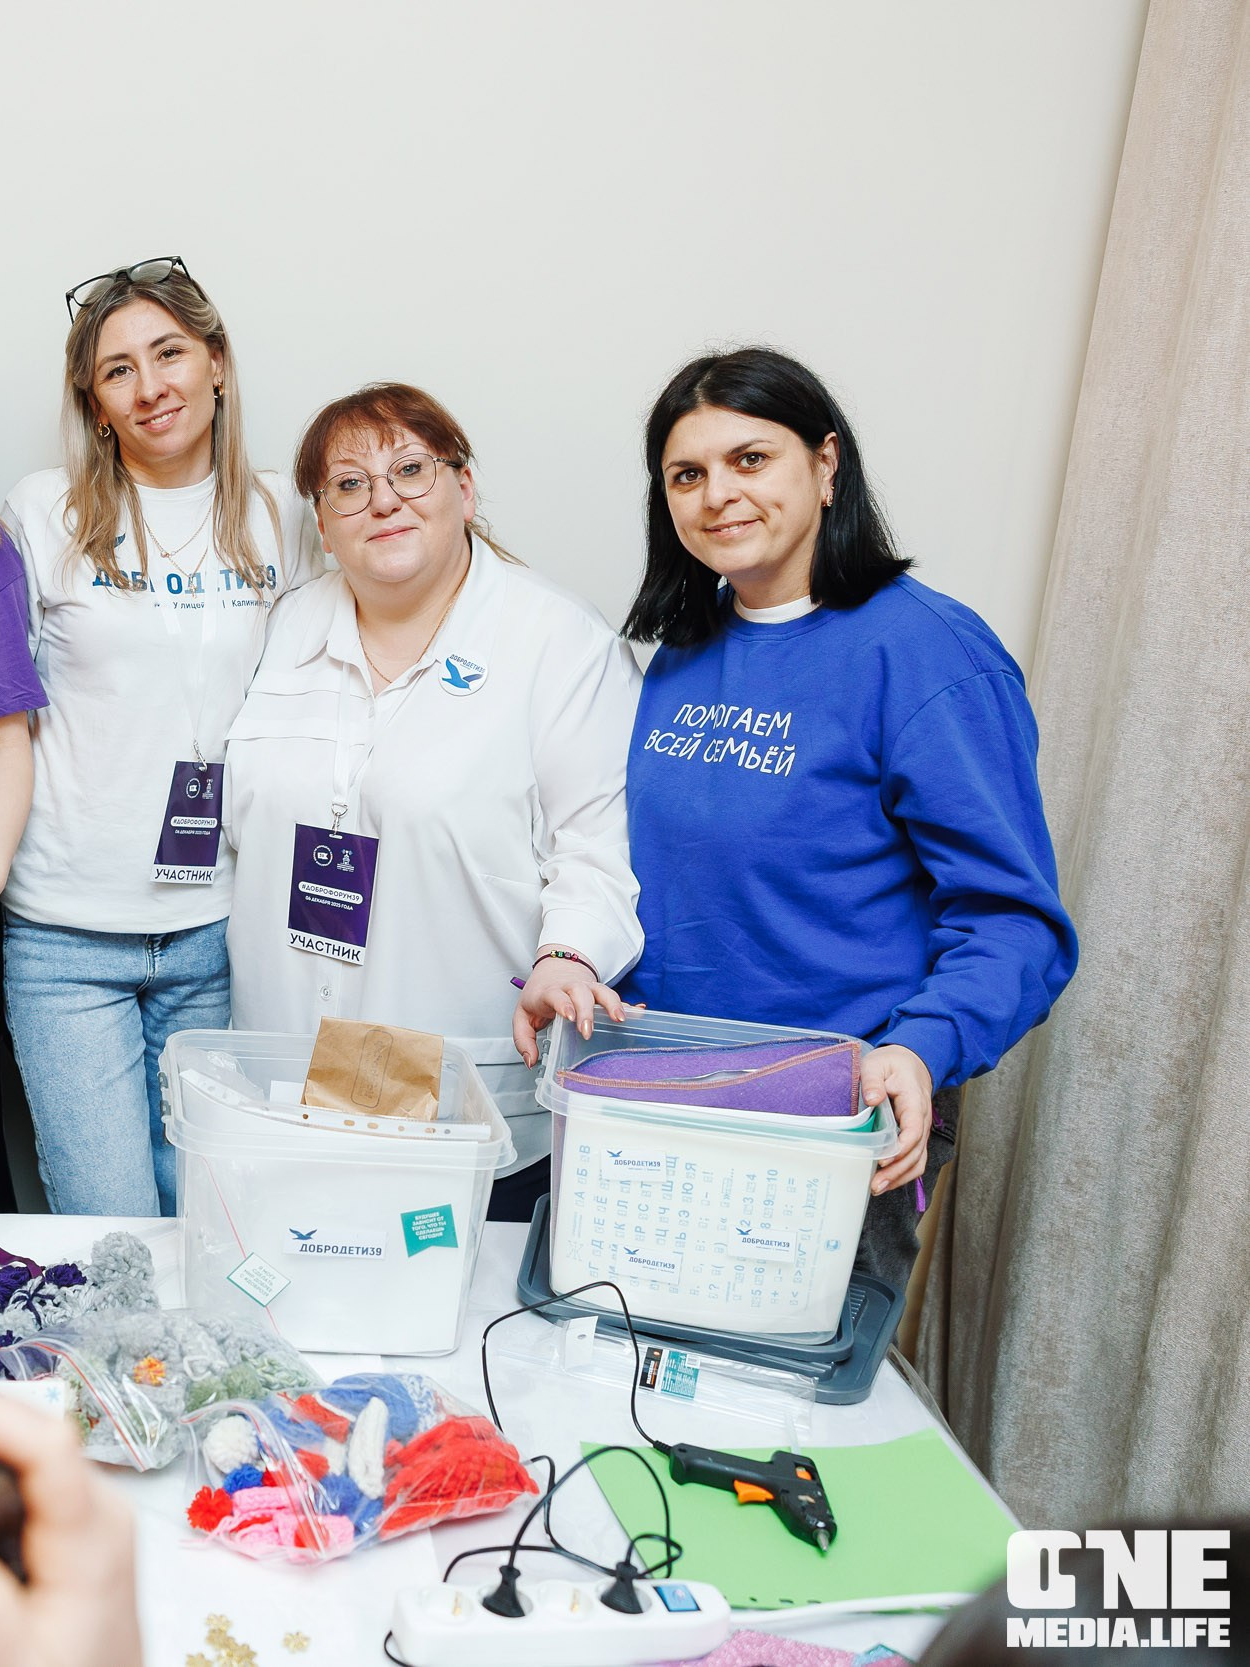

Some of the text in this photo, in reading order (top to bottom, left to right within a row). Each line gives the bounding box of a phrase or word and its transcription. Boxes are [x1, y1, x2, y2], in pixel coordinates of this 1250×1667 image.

[673, 703, 792, 740] ПОМОГАЕМ
[644, 729, 796, 777] ВСЕЙ СЕМЬЁЙ
[154, 868, 213, 882] УЧАСТНИК
[290, 932, 361, 962] УЧАСТНИК
[614, 1159, 661, 1167] ДОБРОДЕТИ39
[299, 1243, 382, 1256] ДОБРОДЕТИ39
[741, 1237, 790, 1248] ДОБРОДЕТИ39
[628, 1256, 675, 1270] ДОБРОДЕТИ39
